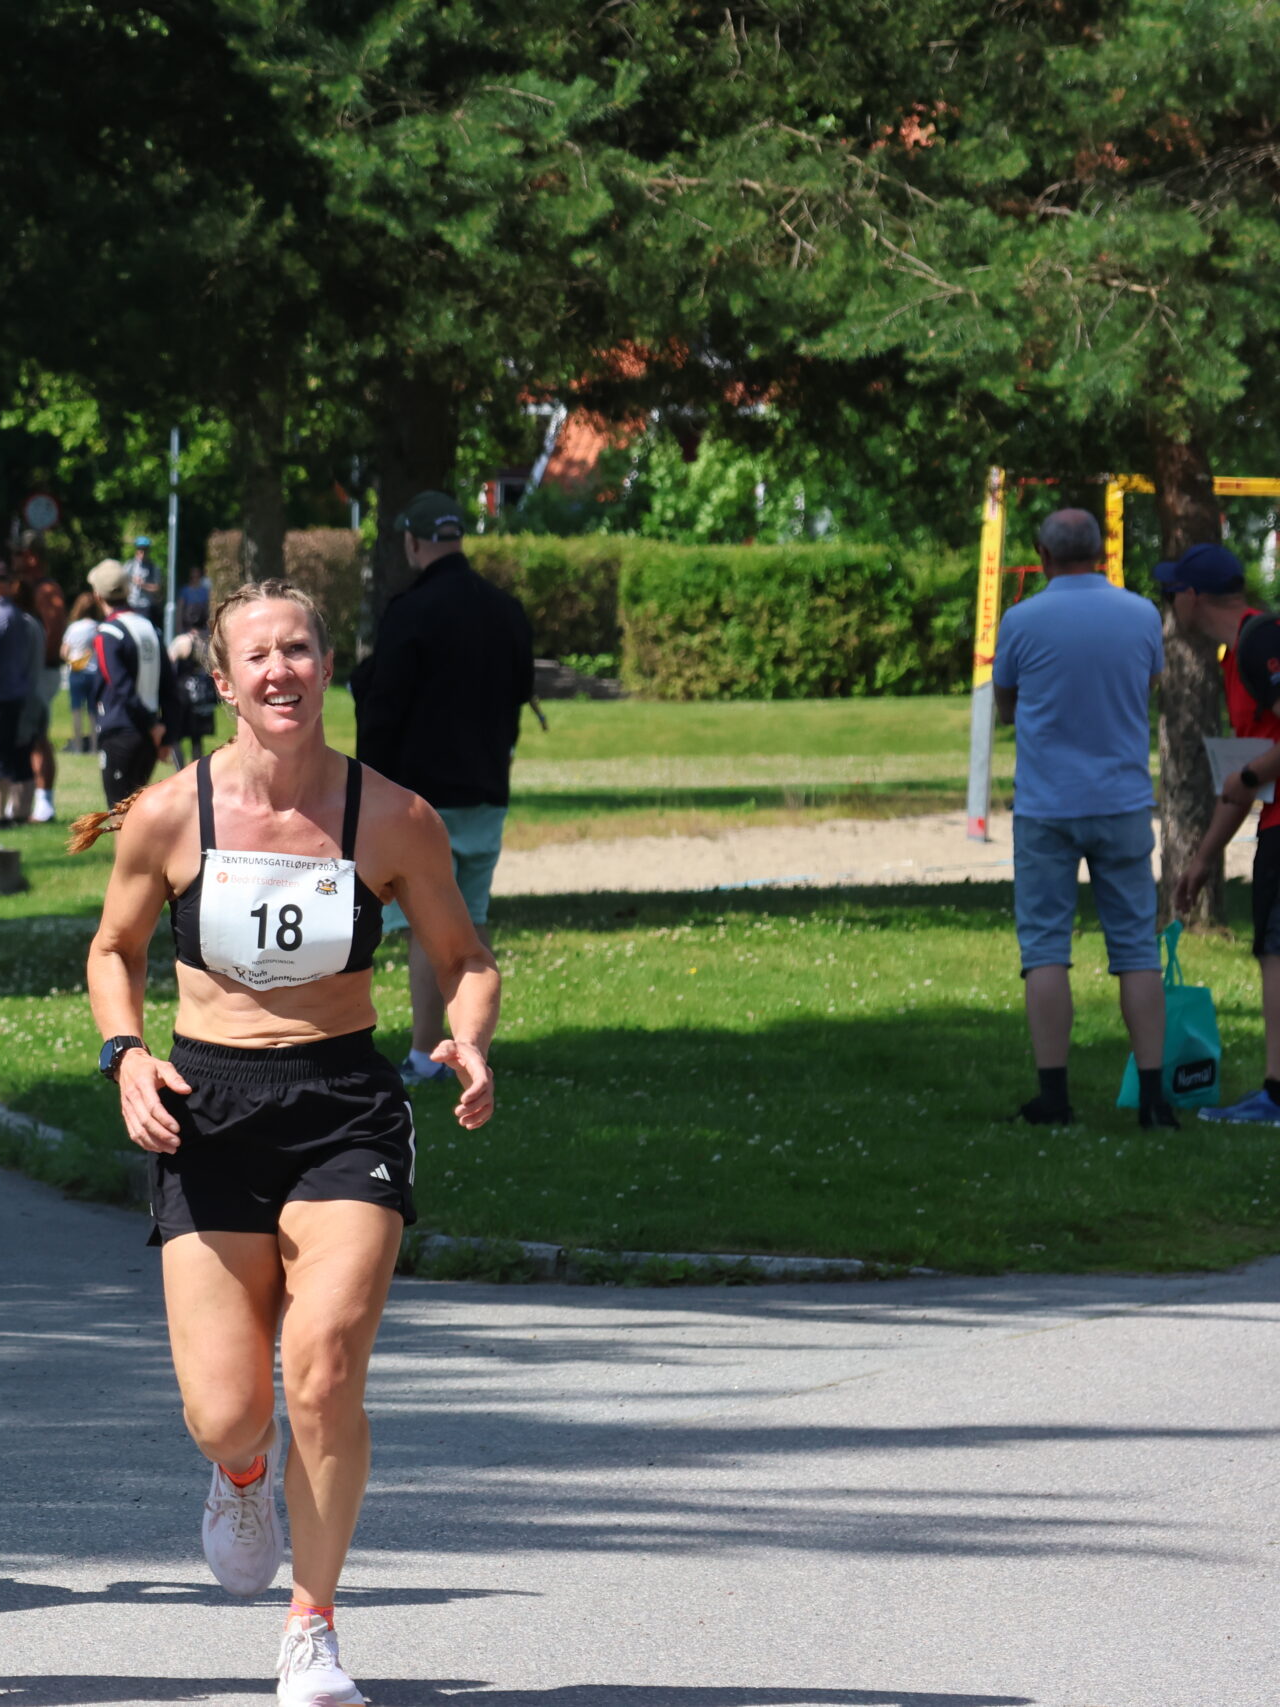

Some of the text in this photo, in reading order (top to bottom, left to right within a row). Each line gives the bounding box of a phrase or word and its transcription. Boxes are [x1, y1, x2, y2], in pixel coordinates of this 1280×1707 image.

[221, 856, 340, 872] SENTRUMSGATELØPET 2025
[250, 902, 303, 952] 18
